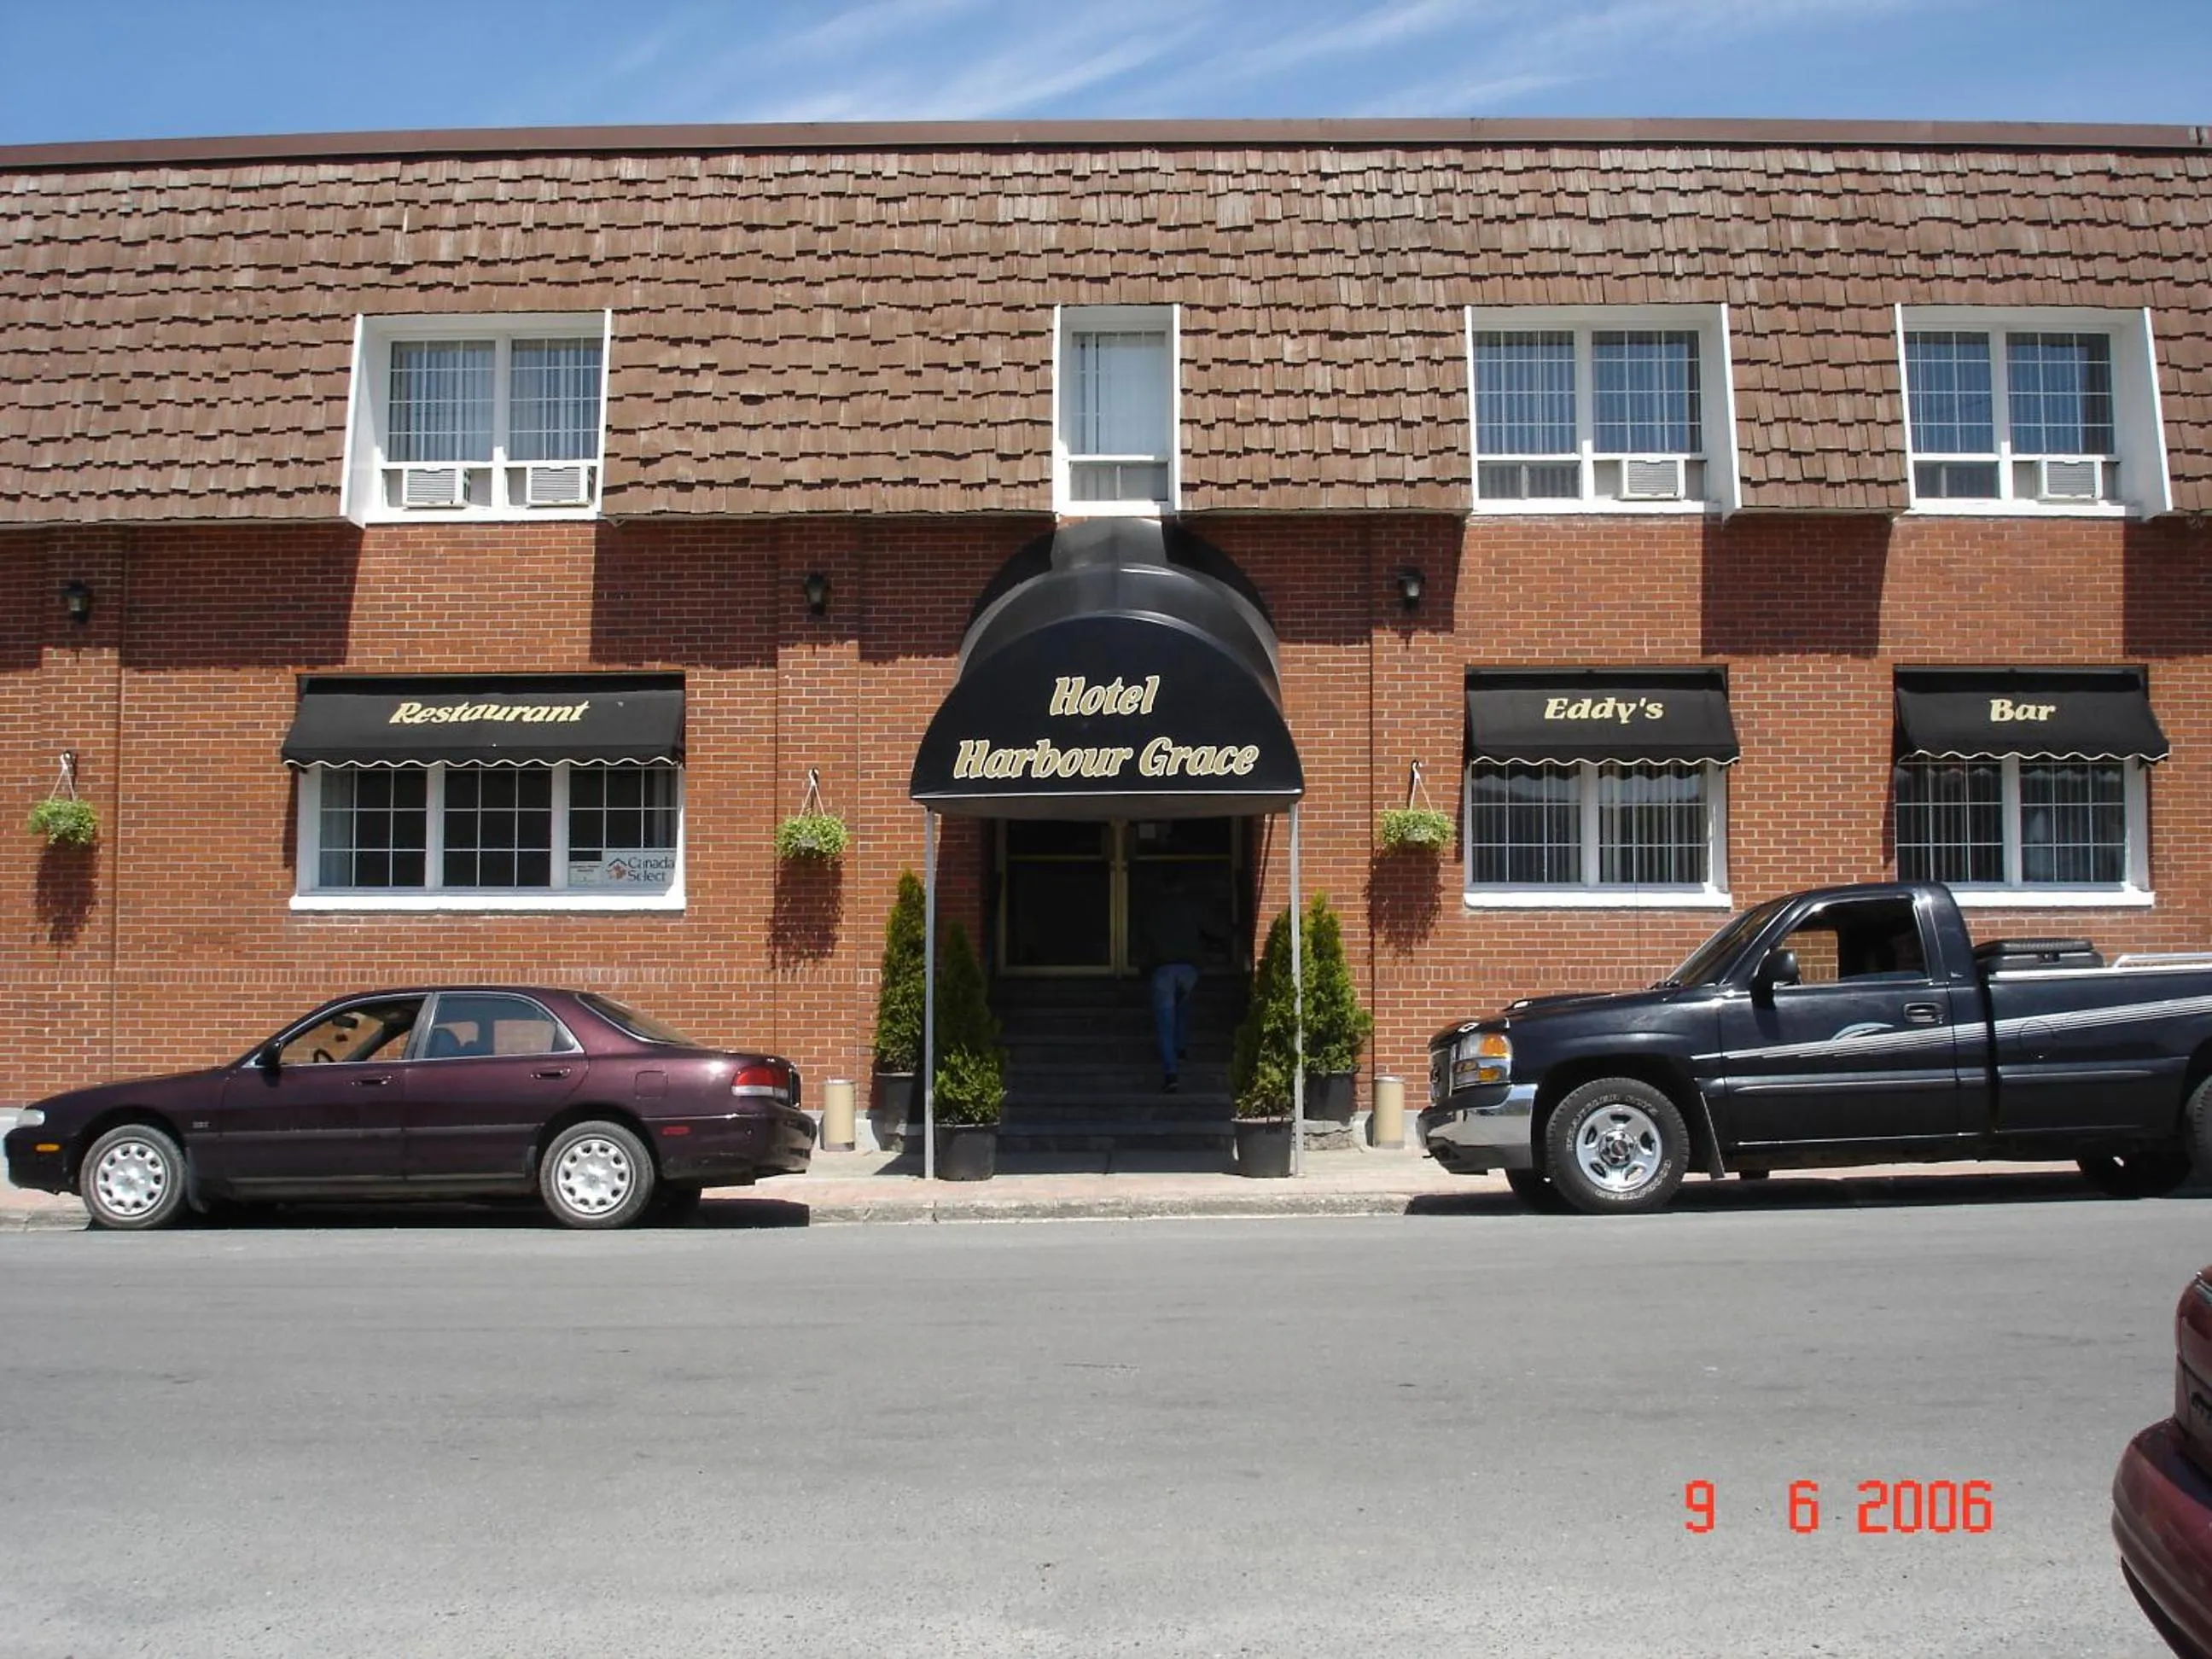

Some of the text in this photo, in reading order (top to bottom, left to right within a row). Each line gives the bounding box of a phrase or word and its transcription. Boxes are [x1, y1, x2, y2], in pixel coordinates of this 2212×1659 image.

[1049, 675, 1161, 716] Hotel
[388, 700, 591, 724] Restaurant
[1544, 696, 1665, 725] Eddy's
[1989, 699, 2057, 722] Bar
[953, 736, 1260, 778] Harbour Grace
